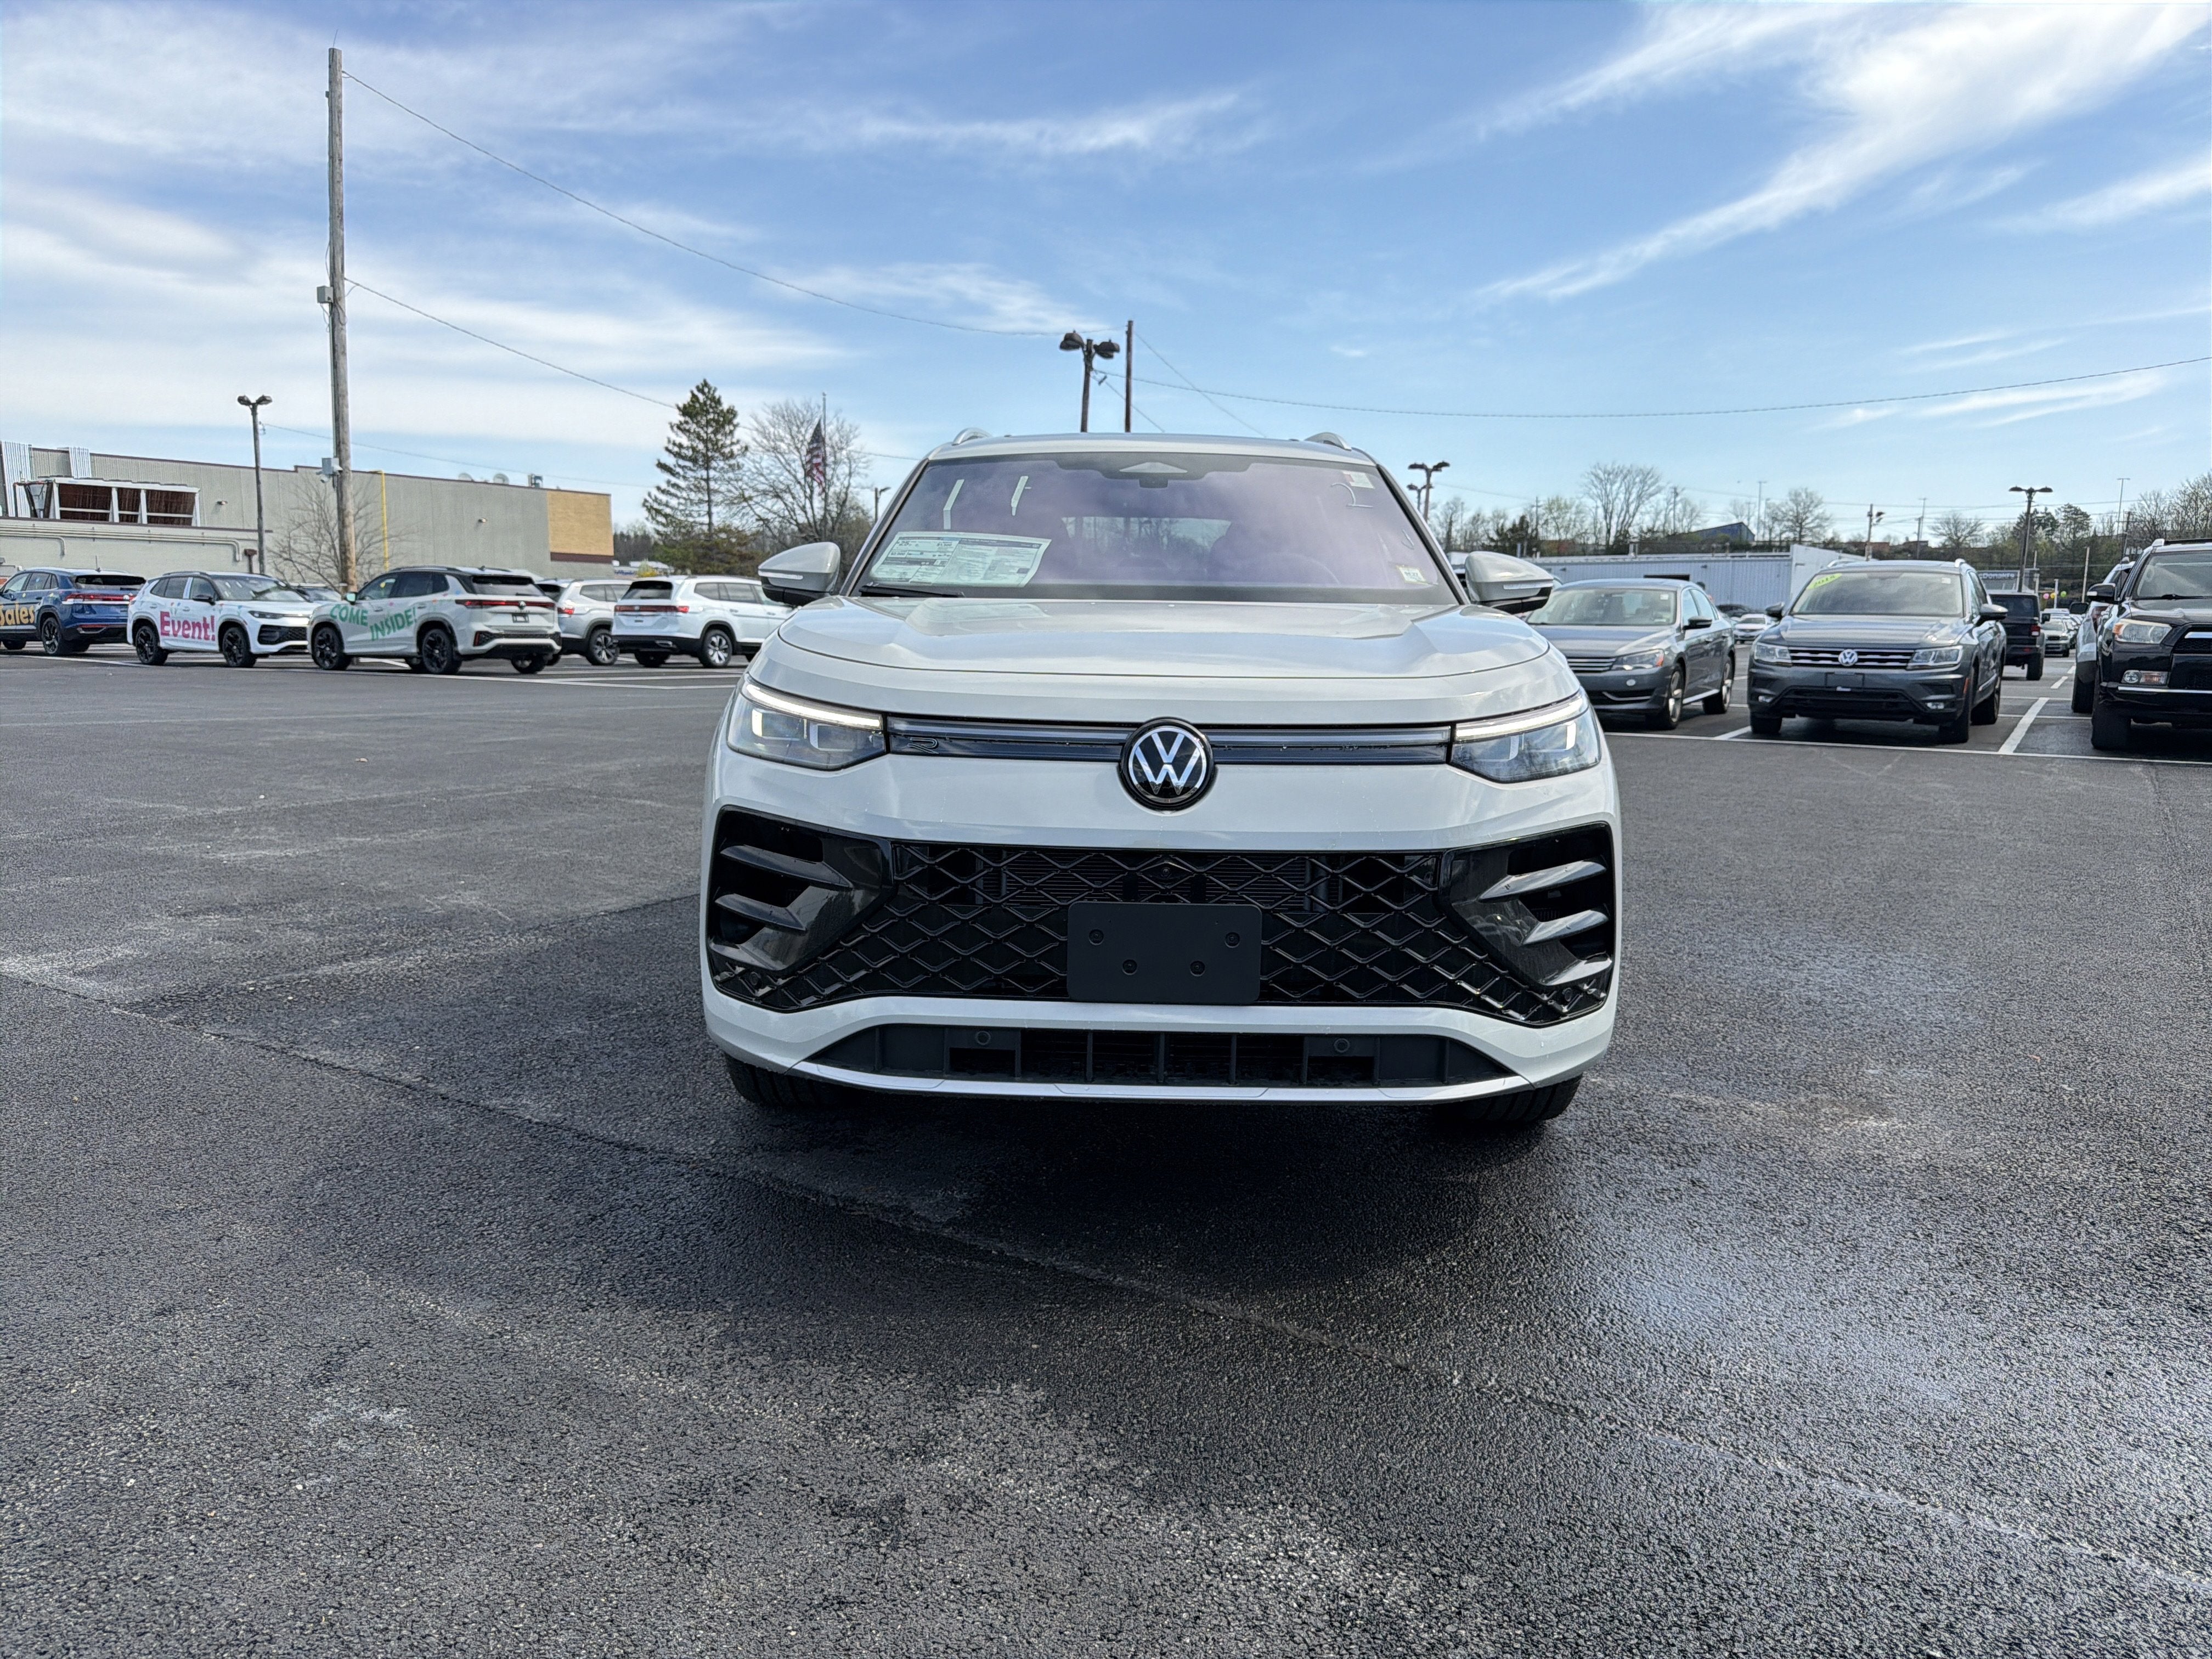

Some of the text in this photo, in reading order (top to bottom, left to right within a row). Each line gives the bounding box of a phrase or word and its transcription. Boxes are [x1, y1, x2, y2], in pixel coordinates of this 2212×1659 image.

[160, 611, 216, 641] Event!
[330, 603, 417, 641] COME INSIDE!
[1130, 728, 1205, 800] VW
